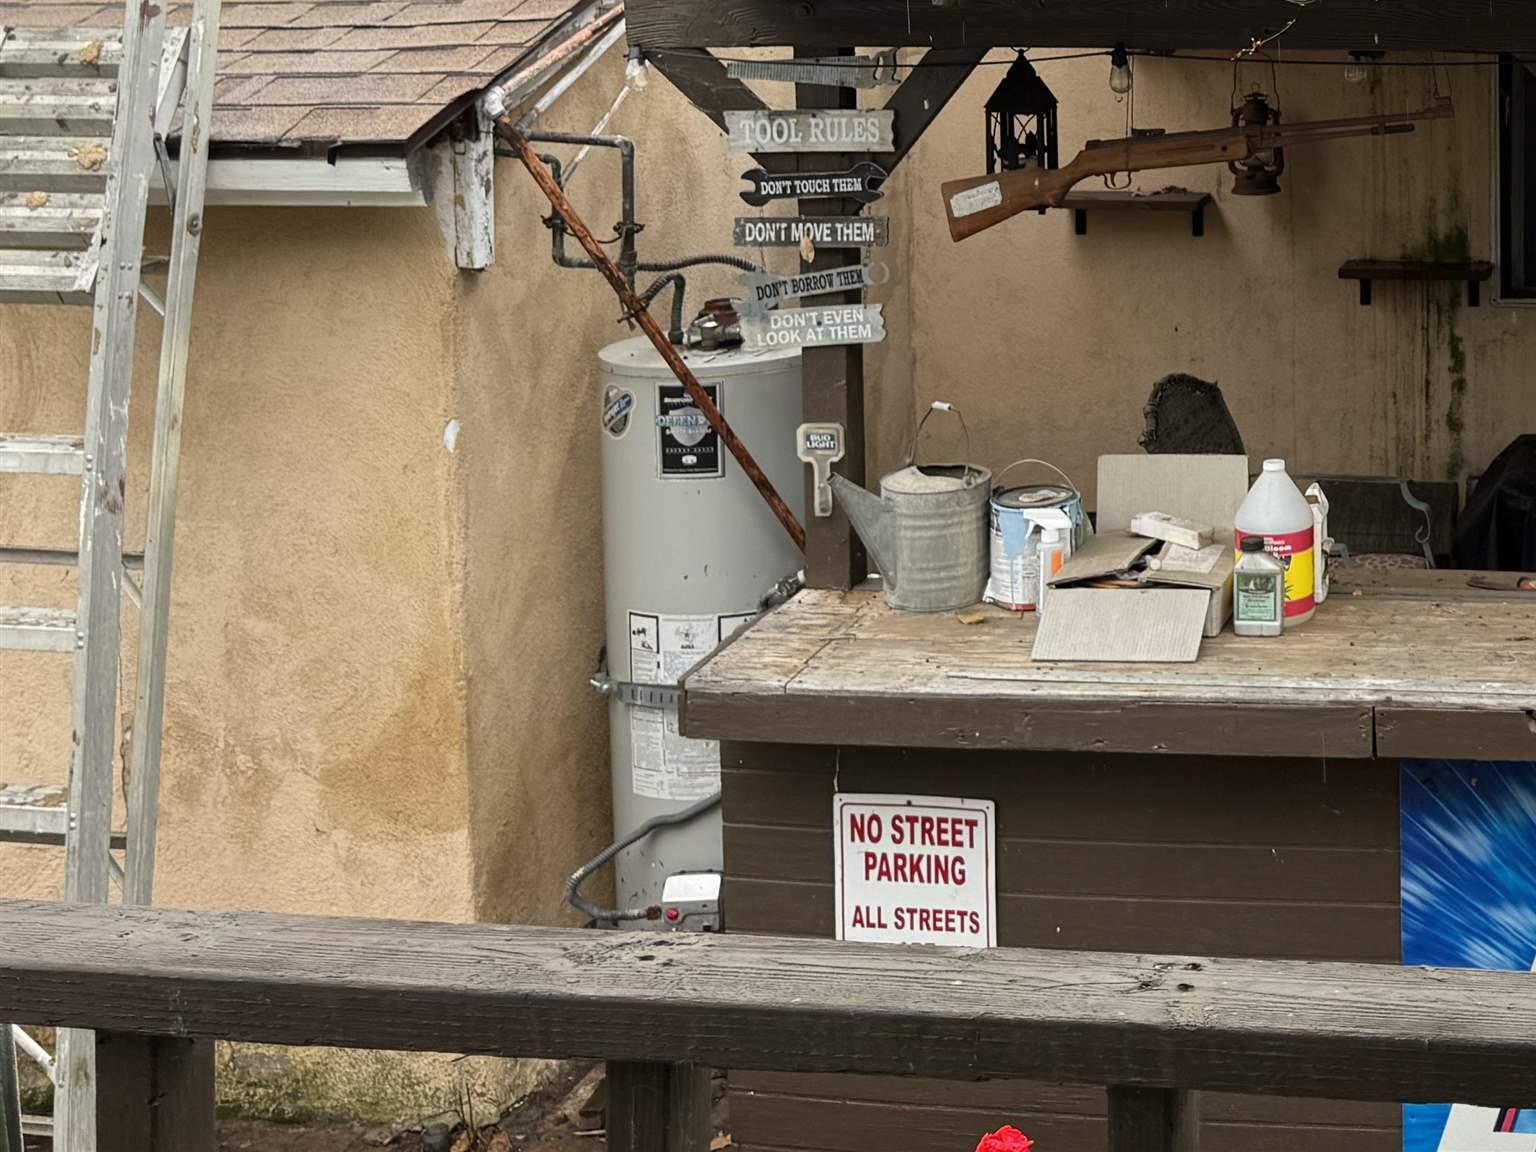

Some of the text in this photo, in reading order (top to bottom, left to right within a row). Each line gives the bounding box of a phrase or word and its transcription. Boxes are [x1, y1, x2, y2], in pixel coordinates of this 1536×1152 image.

[740, 118, 880, 144] TOOL RULES
[760, 177, 863, 195] DON'T TOUCH THEM
[745, 223, 874, 241] DON'T MOVE THEM
[756, 268, 864, 301] DON'T BORROW THEM
[770, 308, 864, 330] DON'T EVEN
[757, 324, 872, 346] LOOK AT THEM
[850, 813, 978, 848] NO STREET
[864, 851, 966, 886] PARKING
[852, 905, 981, 935] ALL STREETS
